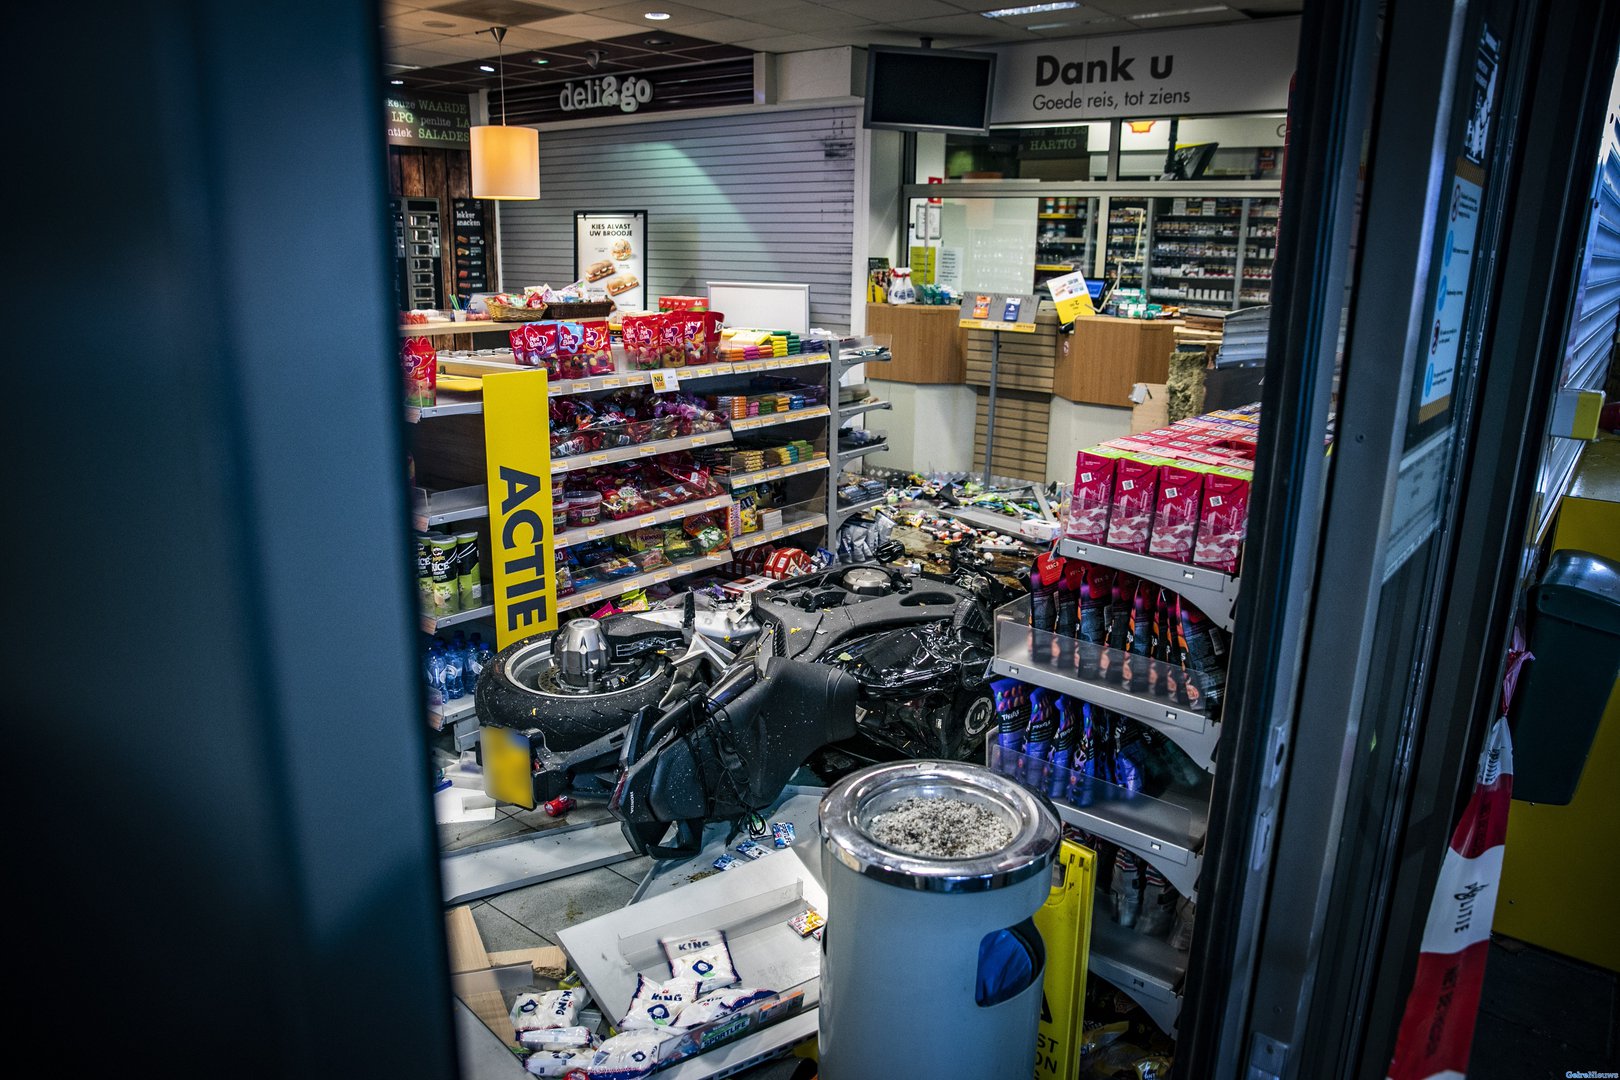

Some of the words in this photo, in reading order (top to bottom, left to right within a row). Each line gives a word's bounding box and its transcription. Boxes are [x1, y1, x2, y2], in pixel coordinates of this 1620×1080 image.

[1035, 46, 1136, 87] Dank
[1150, 55, 1174, 80] u
[560, 76, 654, 112] deli2go
[1032, 90, 1082, 111] Goede
[1087, 91, 1118, 110] reis,
[1124, 91, 1144, 106] tot
[1148, 88, 1191, 105] ziens
[392, 111, 414, 124] LPG
[418, 129, 470, 142] SALADES
[1030, 139, 1077, 151] HARTIG
[499, 465, 548, 632] ACTIE
[678, 940, 711, 951] KING
[555, 990, 573, 1016] KING
[651, 992, 683, 1001] KING
[703, 1020, 748, 1049] SPORTLIFE
